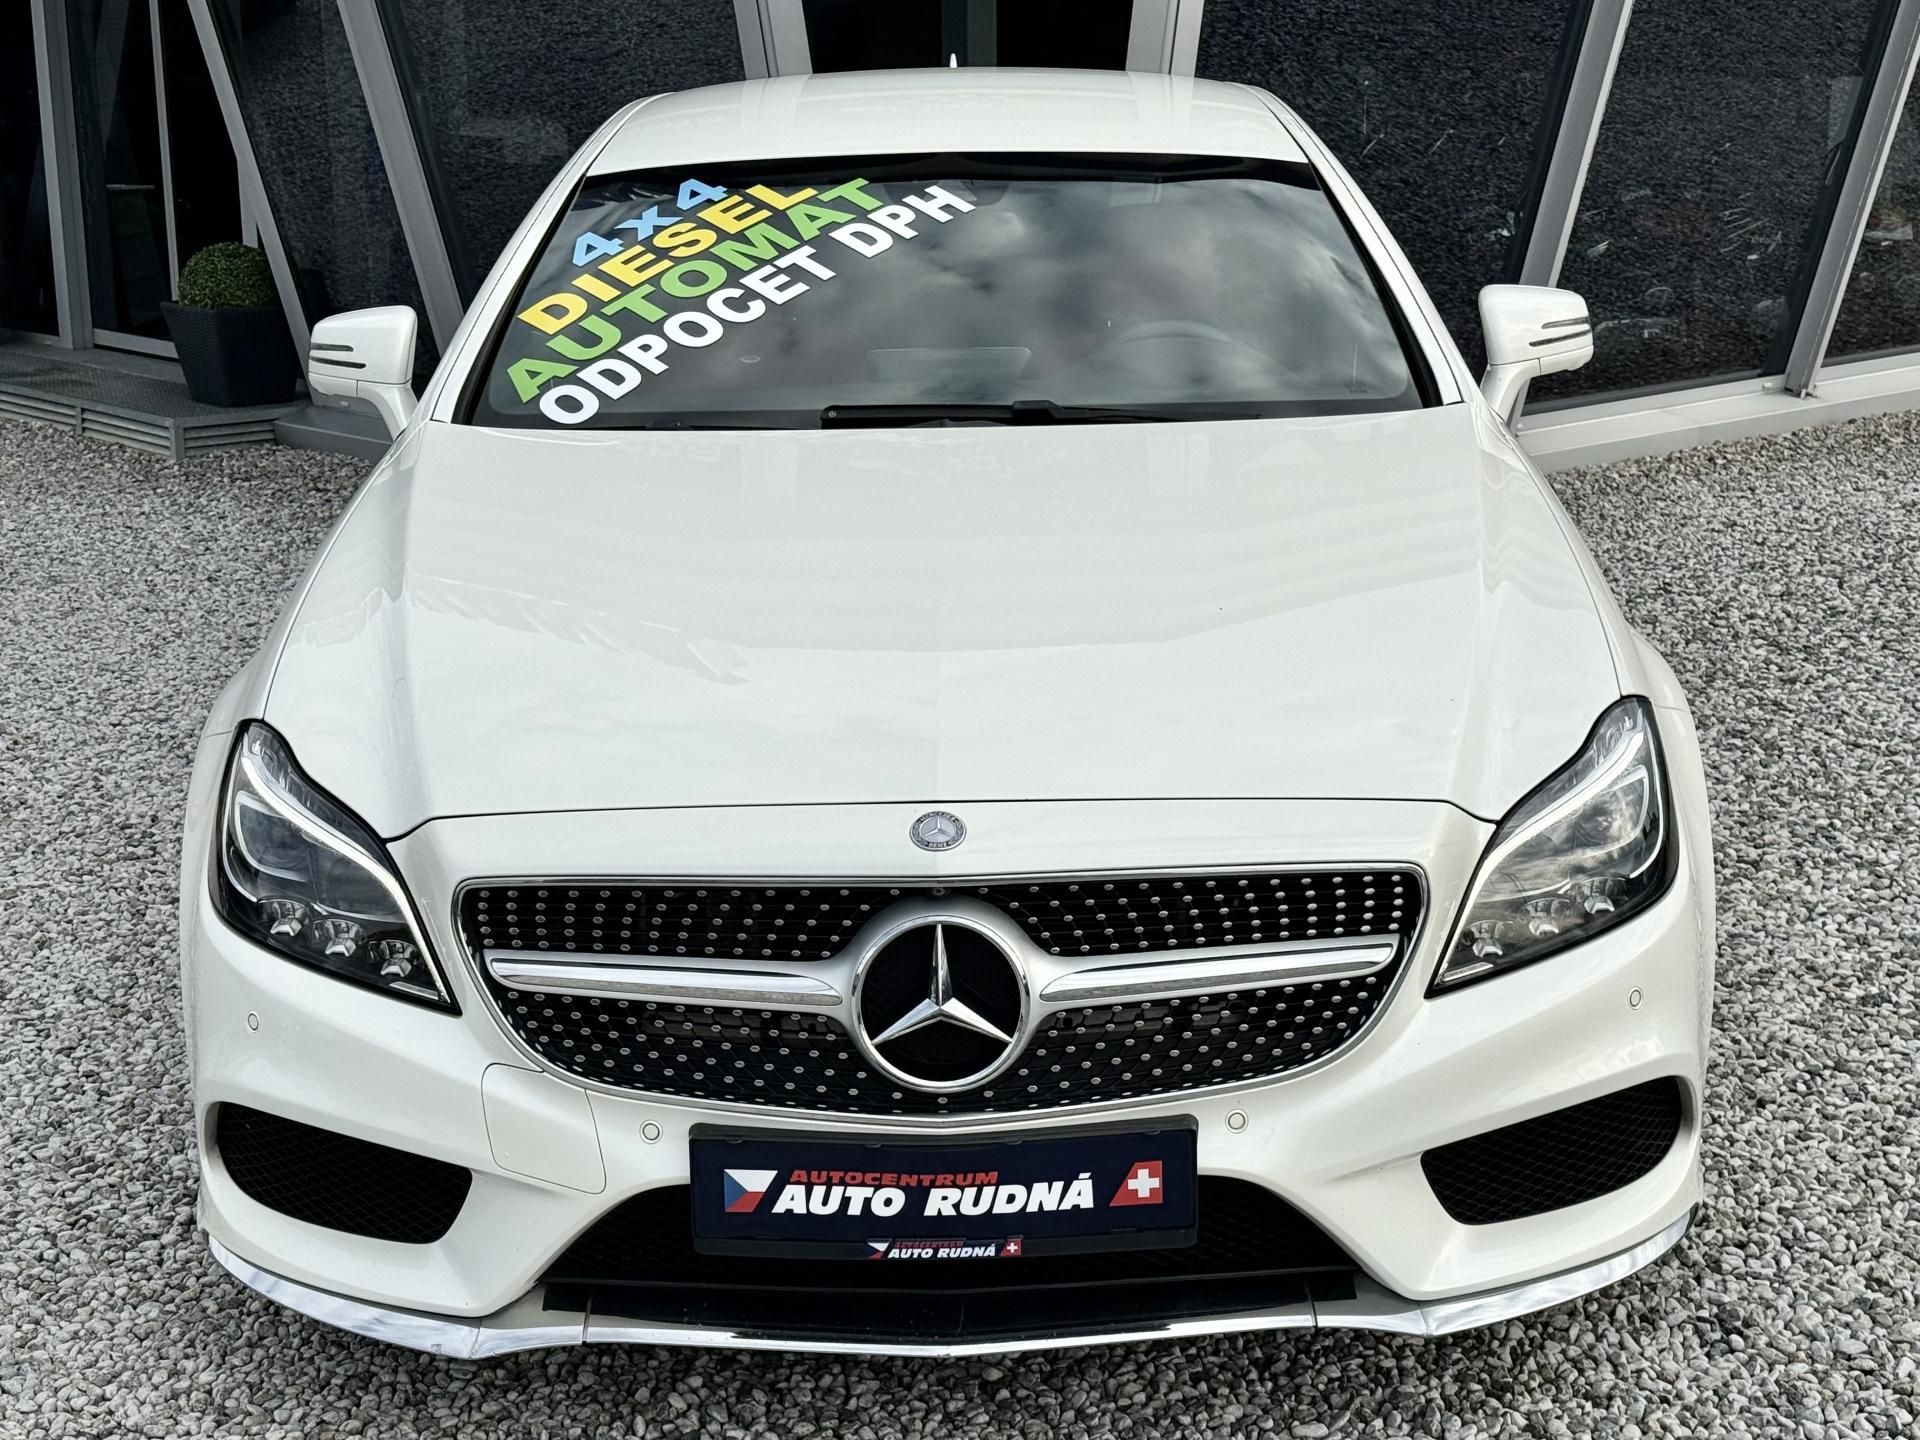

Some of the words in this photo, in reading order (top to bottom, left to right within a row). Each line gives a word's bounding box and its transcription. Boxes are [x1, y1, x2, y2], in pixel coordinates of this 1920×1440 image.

[507, 178, 883, 403] AUTOMAT
[517, 185, 819, 335] DIESEL
[539, 246, 836, 424] ODPOCET
[828, 186, 977, 258] DPH
[772, 1185, 906, 1217] AUTO
[924, 1173, 1094, 1217] RUDNÁ
[790, 1169, 998, 1186] AUTOCENTRUM
[887, 1248, 934, 1259] AUTO
[937, 1243, 996, 1258] RUDNÁ
